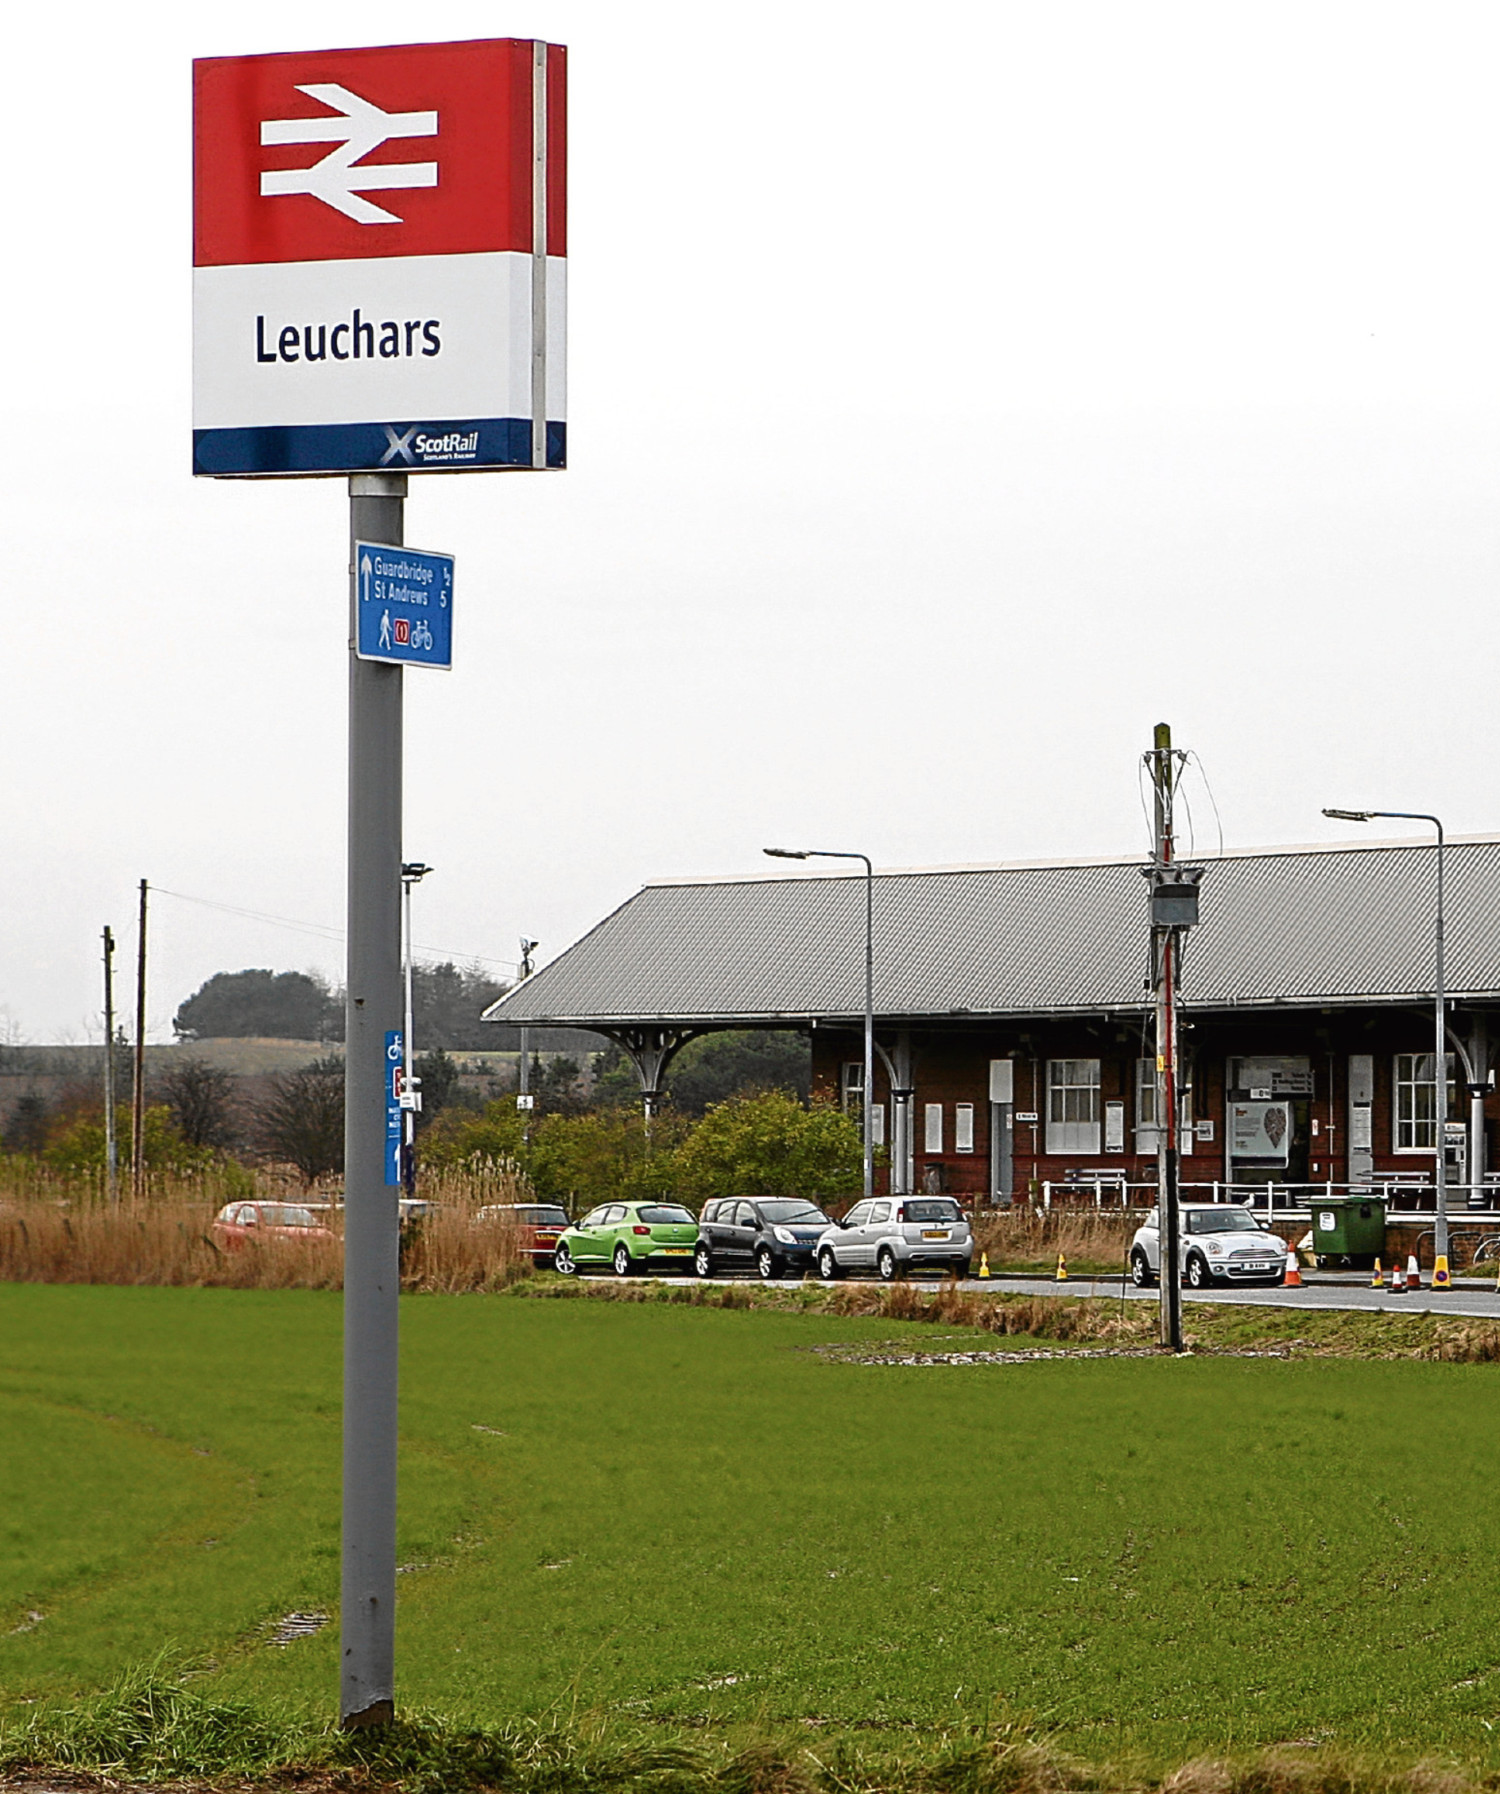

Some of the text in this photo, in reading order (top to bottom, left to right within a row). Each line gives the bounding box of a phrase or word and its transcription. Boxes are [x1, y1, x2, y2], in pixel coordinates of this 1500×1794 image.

[257, 308, 441, 362] Leuchars
[415, 432, 479, 453] ScotRail
[374, 557, 433, 585] Guardbridge
[375, 581, 447, 607] St Andrews 5
